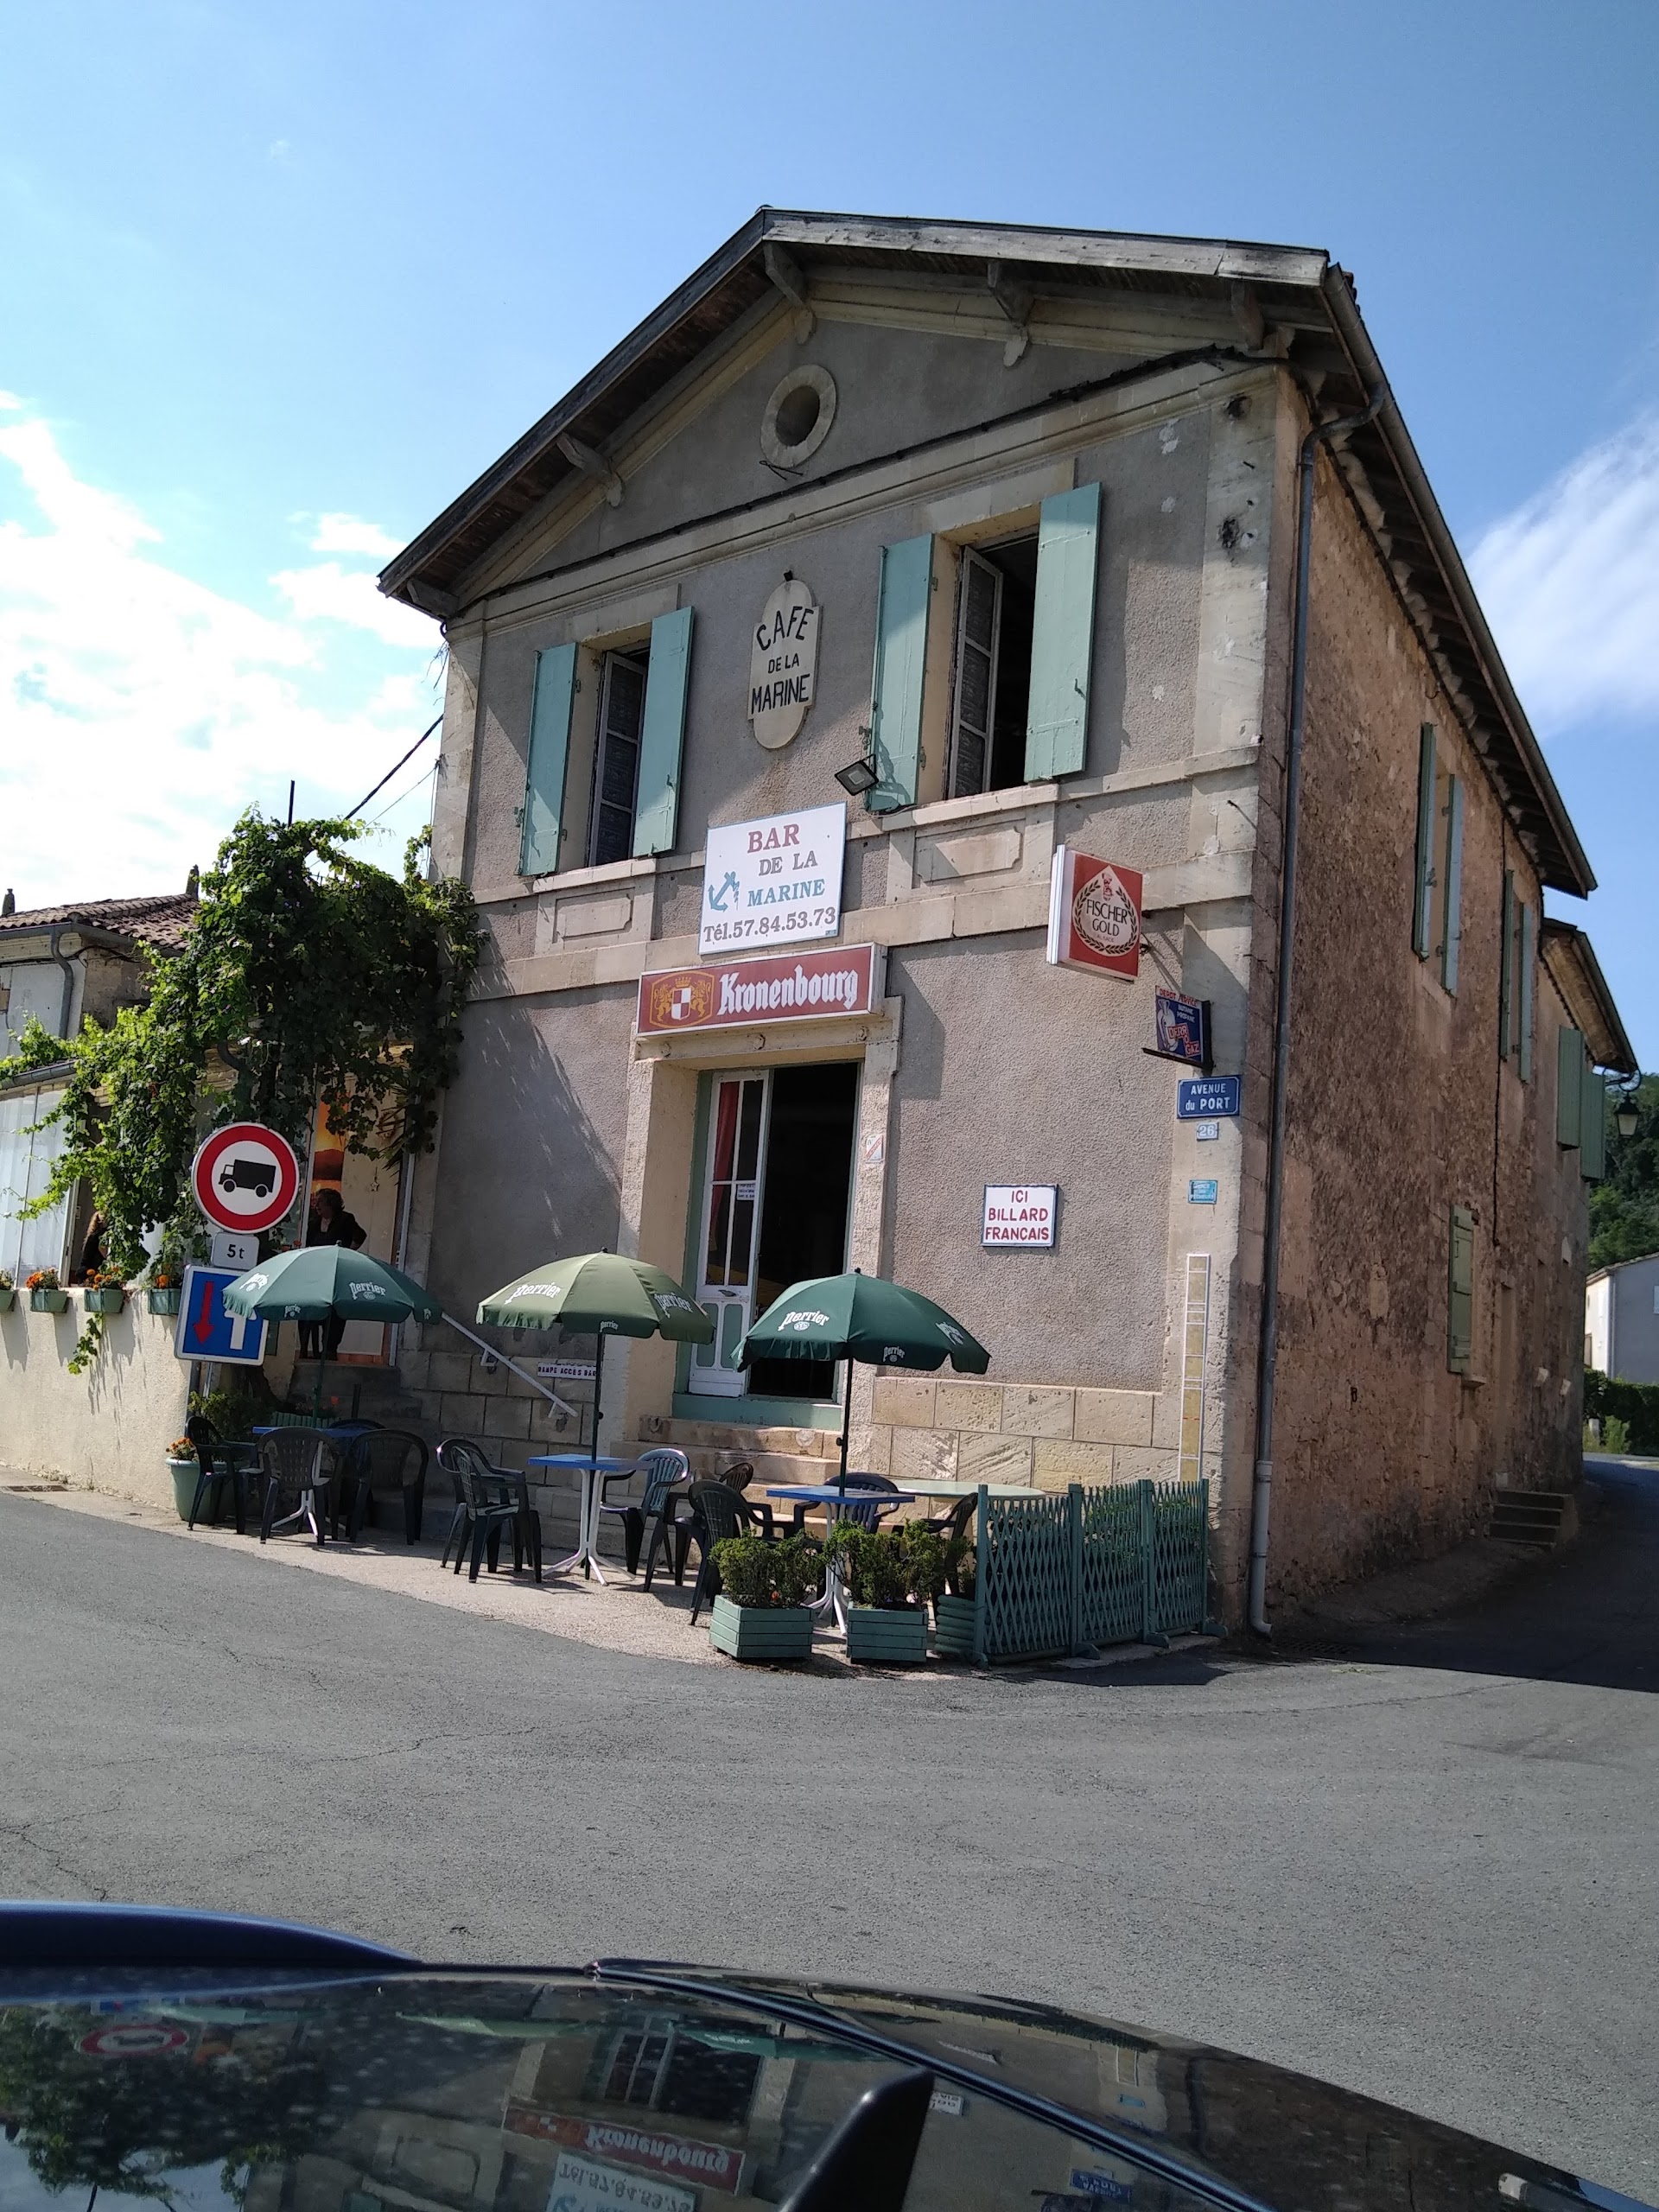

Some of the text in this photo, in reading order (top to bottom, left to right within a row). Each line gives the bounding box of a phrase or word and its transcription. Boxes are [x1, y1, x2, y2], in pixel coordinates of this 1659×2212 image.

[756, 606, 814, 651] CAFE
[767, 652, 799, 673] DE LA
[751, 673, 810, 715] MARINE
[747, 823, 799, 853] BAR
[759, 850, 817, 876] DE LA
[747, 879, 824, 906] MARINE
[1086, 899, 1128, 925] FISCHER
[703, 906, 836, 943] Tél.57.84.53.73
[1092, 918, 1120, 937] GOLD
[716, 964, 858, 1015] Kronenbourg
[1185, 1042, 1200, 1055] GAZ
[1191, 1083, 1226, 1096] AVENUE
[1185, 1097, 1230, 1111] du PORT
[1199, 1126, 1215, 1137] 26
[1011, 1190, 1028, 1203] ICI
[988, 1208, 1049, 1221] BILLARD
